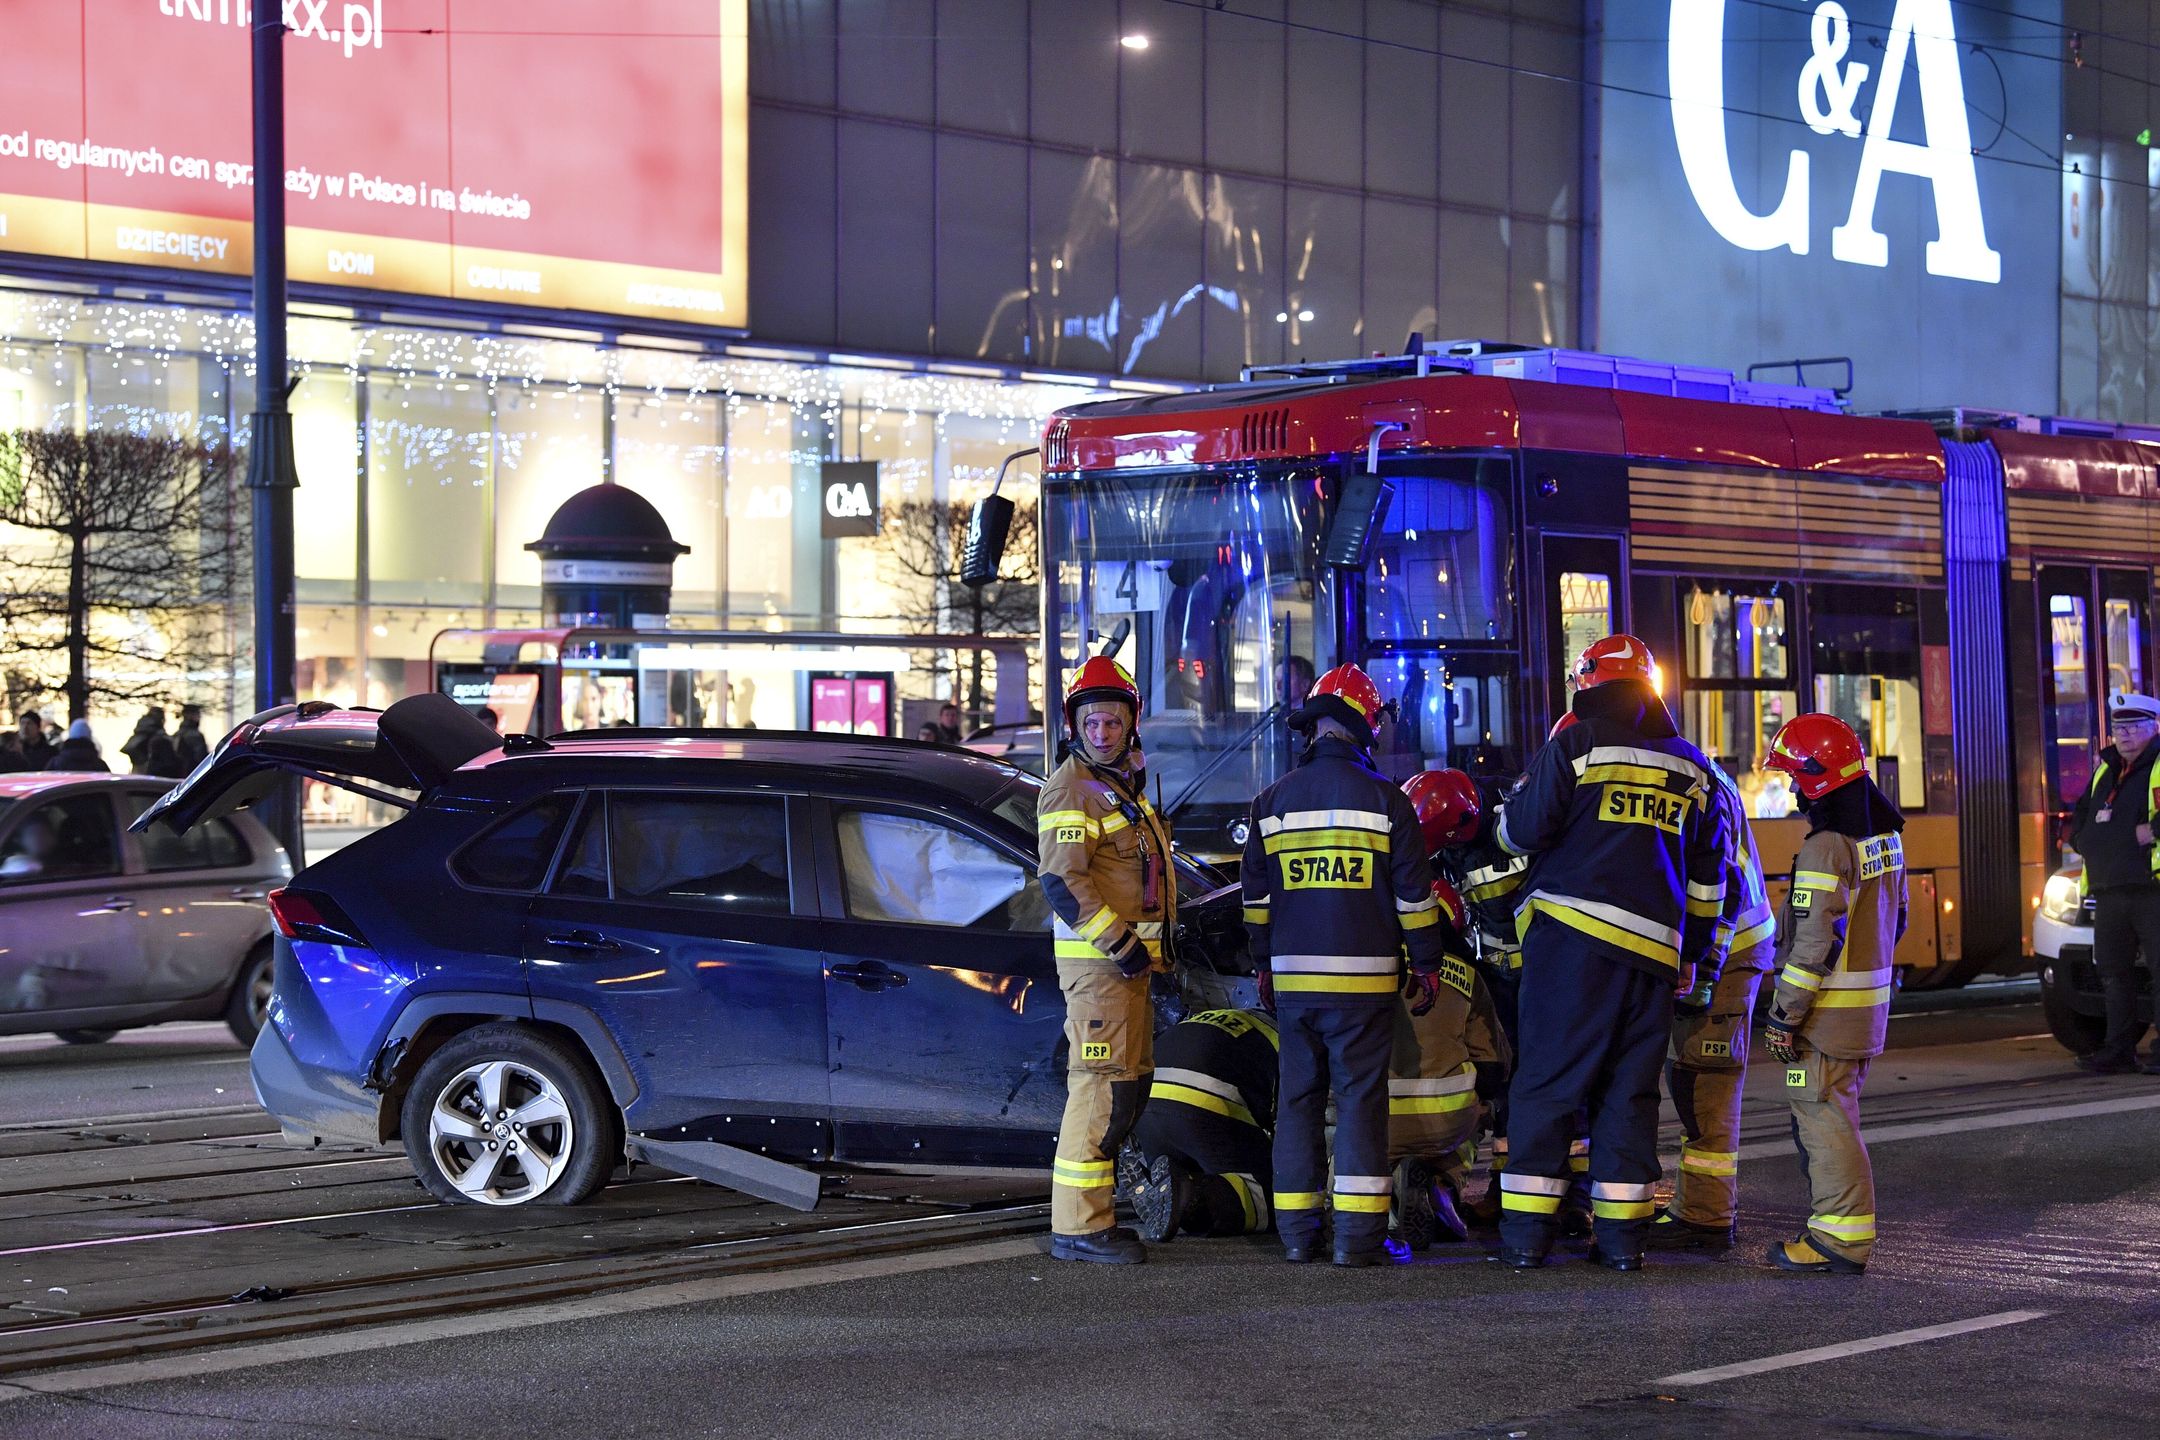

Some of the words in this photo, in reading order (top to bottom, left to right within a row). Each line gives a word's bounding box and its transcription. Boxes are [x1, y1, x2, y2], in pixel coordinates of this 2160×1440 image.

[1668, 0, 2001, 284] C&A
[0, 130, 29, 157] od
[34, 138, 165, 177] regularnych
[169, 155, 210, 180] cen
[214, 161, 321, 200] spraży
[325, 175, 344, 197] w
[348, 172, 417, 206] Polsce
[420, 181, 427, 206] i
[430, 188, 457, 212] na
[459, 186, 532, 220] świecie
[116, 226, 229, 262] DZIECIĘCY
[327, 250, 375, 276] DOM
[1115, 557, 1138, 611] 4
[1060, 830, 1082, 840] PSP
[1793, 892, 1807, 904] PSP
[1085, 1046, 1107, 1057] PSP
[1705, 1043, 1726, 1054] PSP
[1788, 1073, 1801, 1084] PSP
